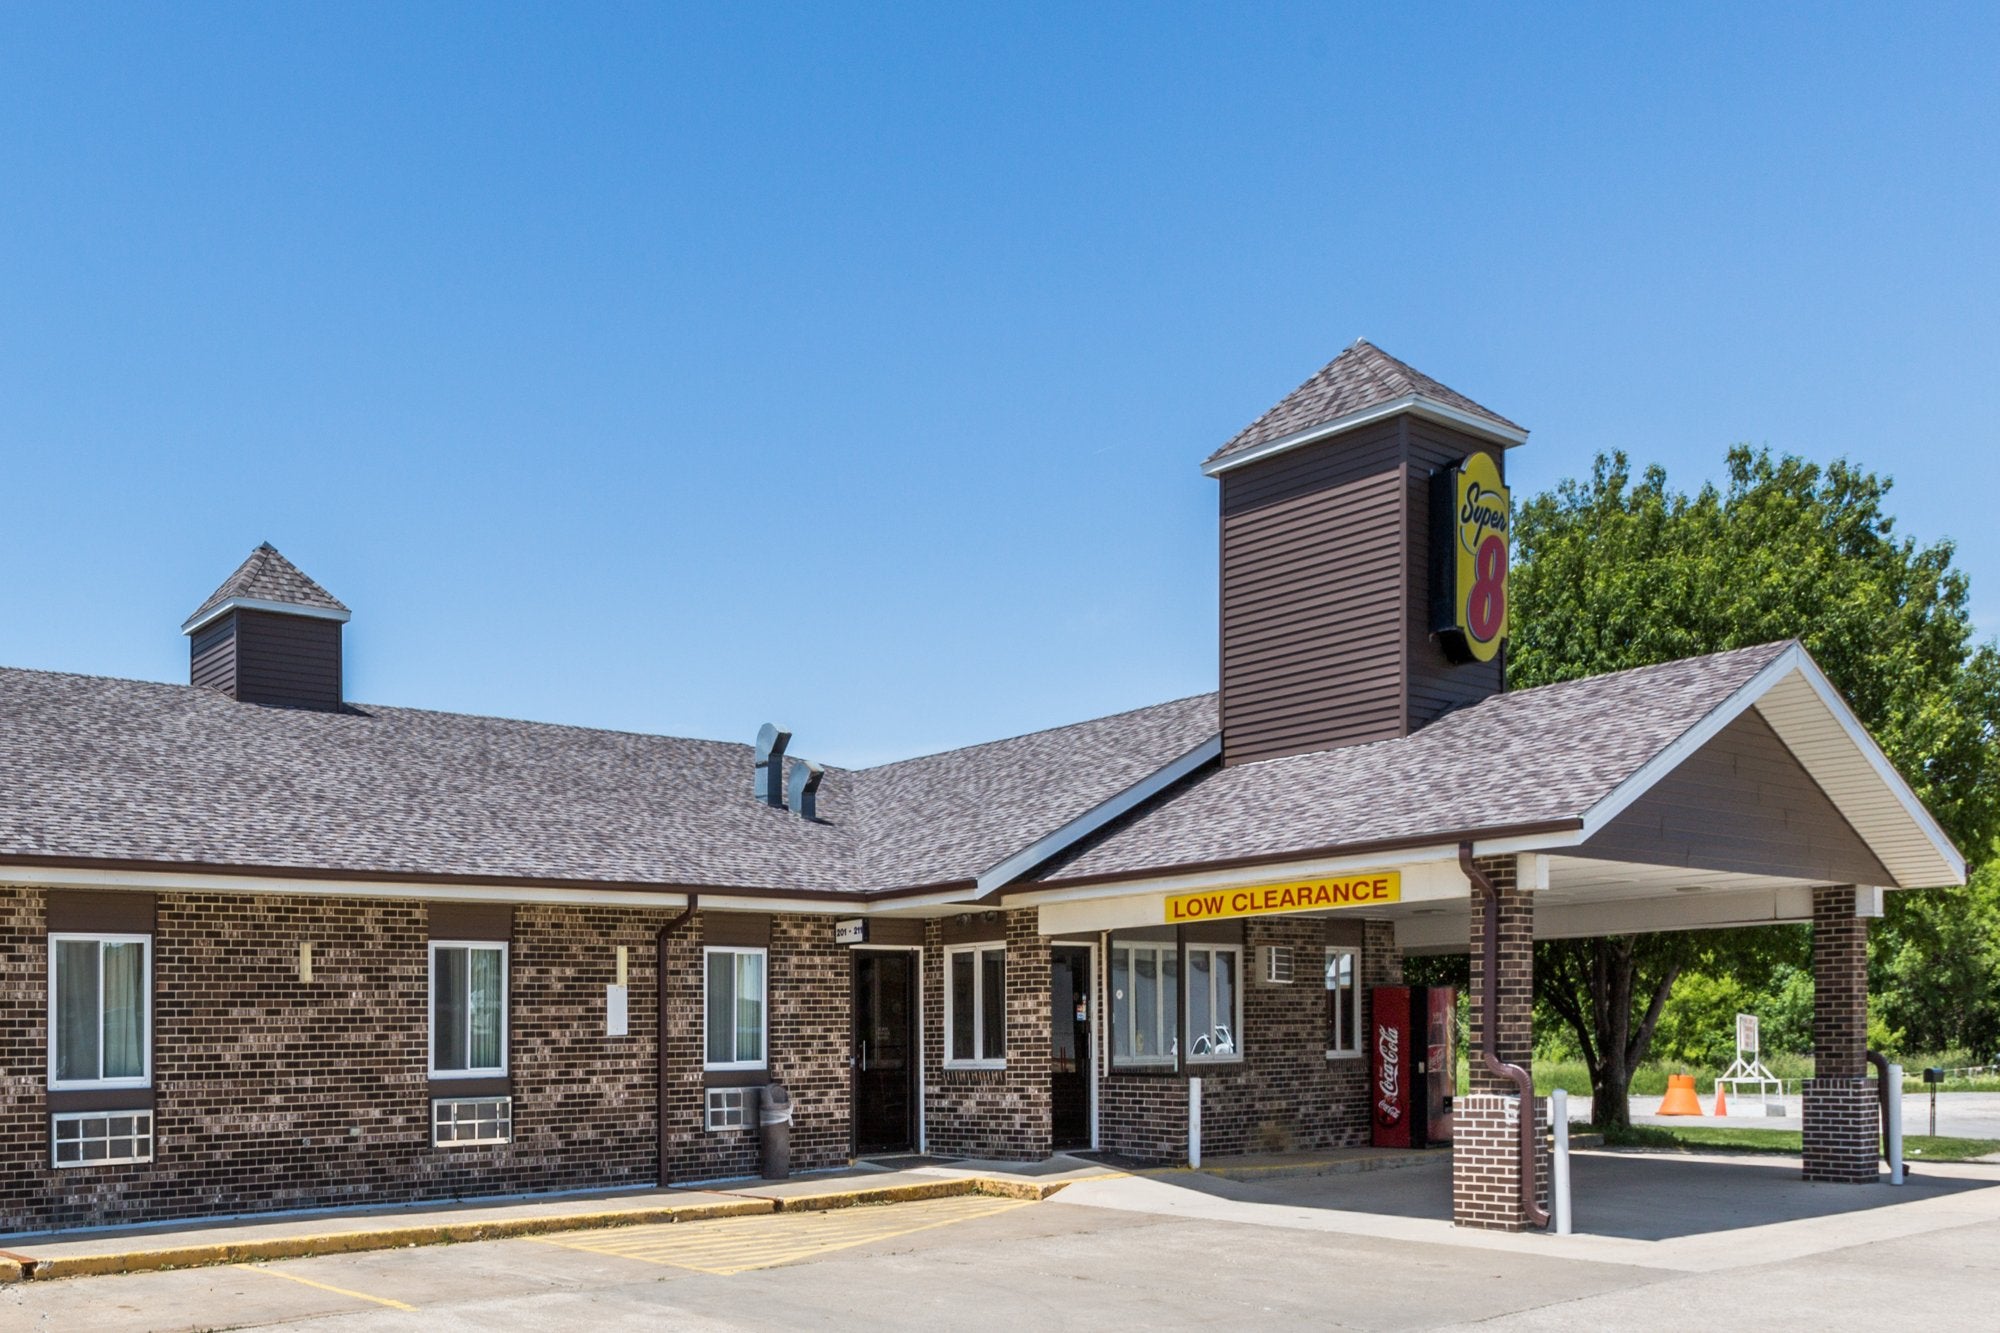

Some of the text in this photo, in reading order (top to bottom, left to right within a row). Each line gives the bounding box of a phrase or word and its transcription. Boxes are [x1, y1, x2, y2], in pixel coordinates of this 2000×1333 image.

[1462, 482, 1507, 547] Super
[1467, 535, 1506, 643] 8
[1174, 879, 1389, 918] LOW CLEARANCE
[837, 928, 847, 937] 201
